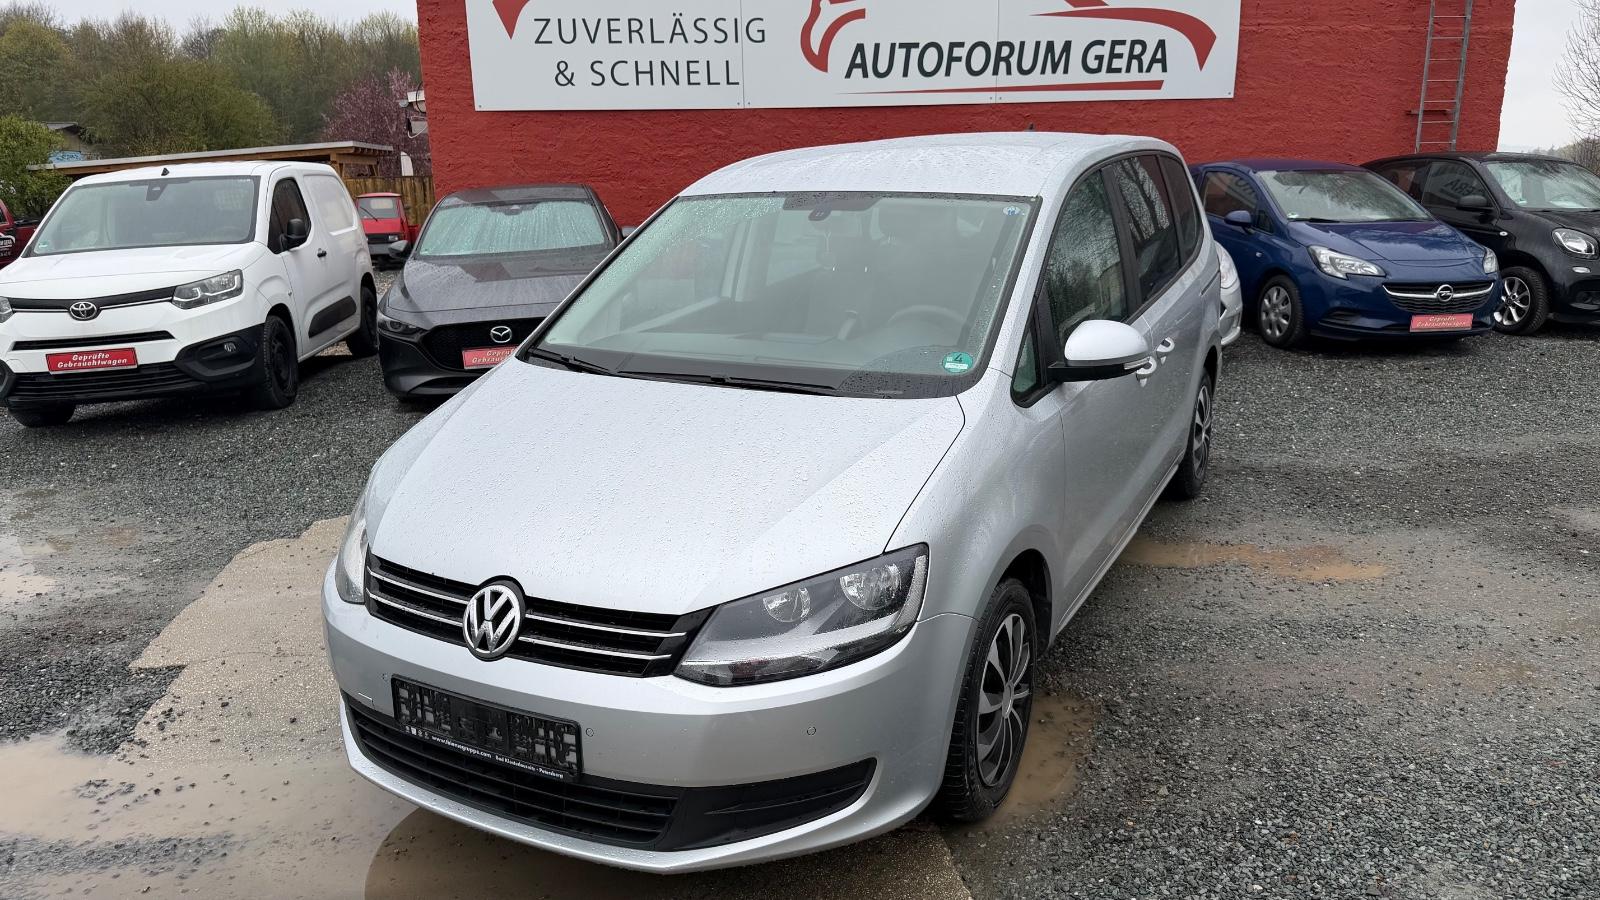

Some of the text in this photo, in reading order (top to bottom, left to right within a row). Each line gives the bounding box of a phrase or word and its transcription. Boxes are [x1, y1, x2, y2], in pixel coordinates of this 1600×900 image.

[533, 12, 767, 45] ZUVERLÄSSIG
[844, 38, 1169, 79] AUTOFORUM GERA
[554, 59, 740, 87] & SCHNELL
[57, 358, 128, 369] Gebrauchtwagen
[72, 352, 110, 361] Geprüfte
[953, 353, 963, 363] 4
